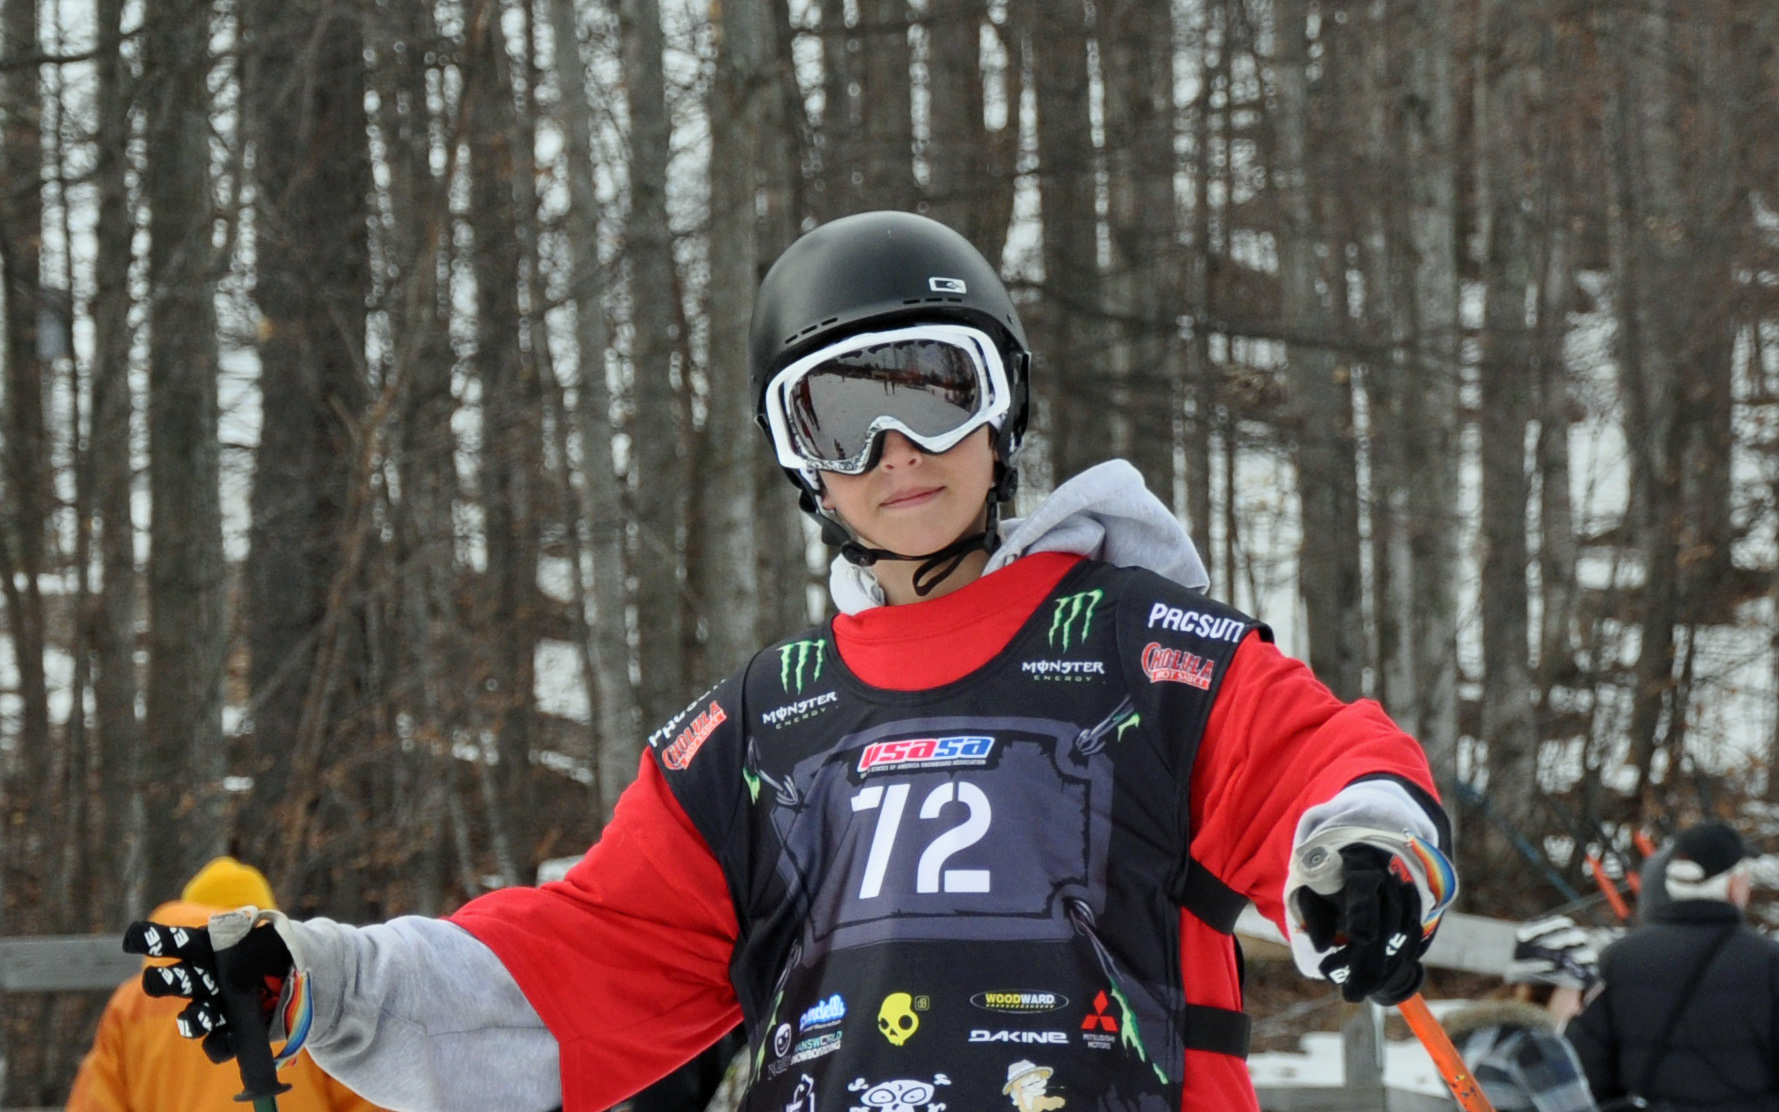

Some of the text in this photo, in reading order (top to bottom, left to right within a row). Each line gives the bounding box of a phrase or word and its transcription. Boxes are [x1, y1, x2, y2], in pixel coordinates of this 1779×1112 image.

[1147, 602, 1245, 643] PACSUN
[1022, 659, 1105, 675] MONSTER
[1141, 642, 1215, 681] CHOLULA
[1033, 675, 1092, 683] ENERGY
[762, 691, 838, 725] MONSTER
[775, 707, 827, 730] ENERGY
[662, 700, 724, 770] CHOLULA
[851, 781, 993, 900] 72
[985, 993, 1055, 1004] WOODWARD
[968, 1030, 1069, 1044] DAKINE
